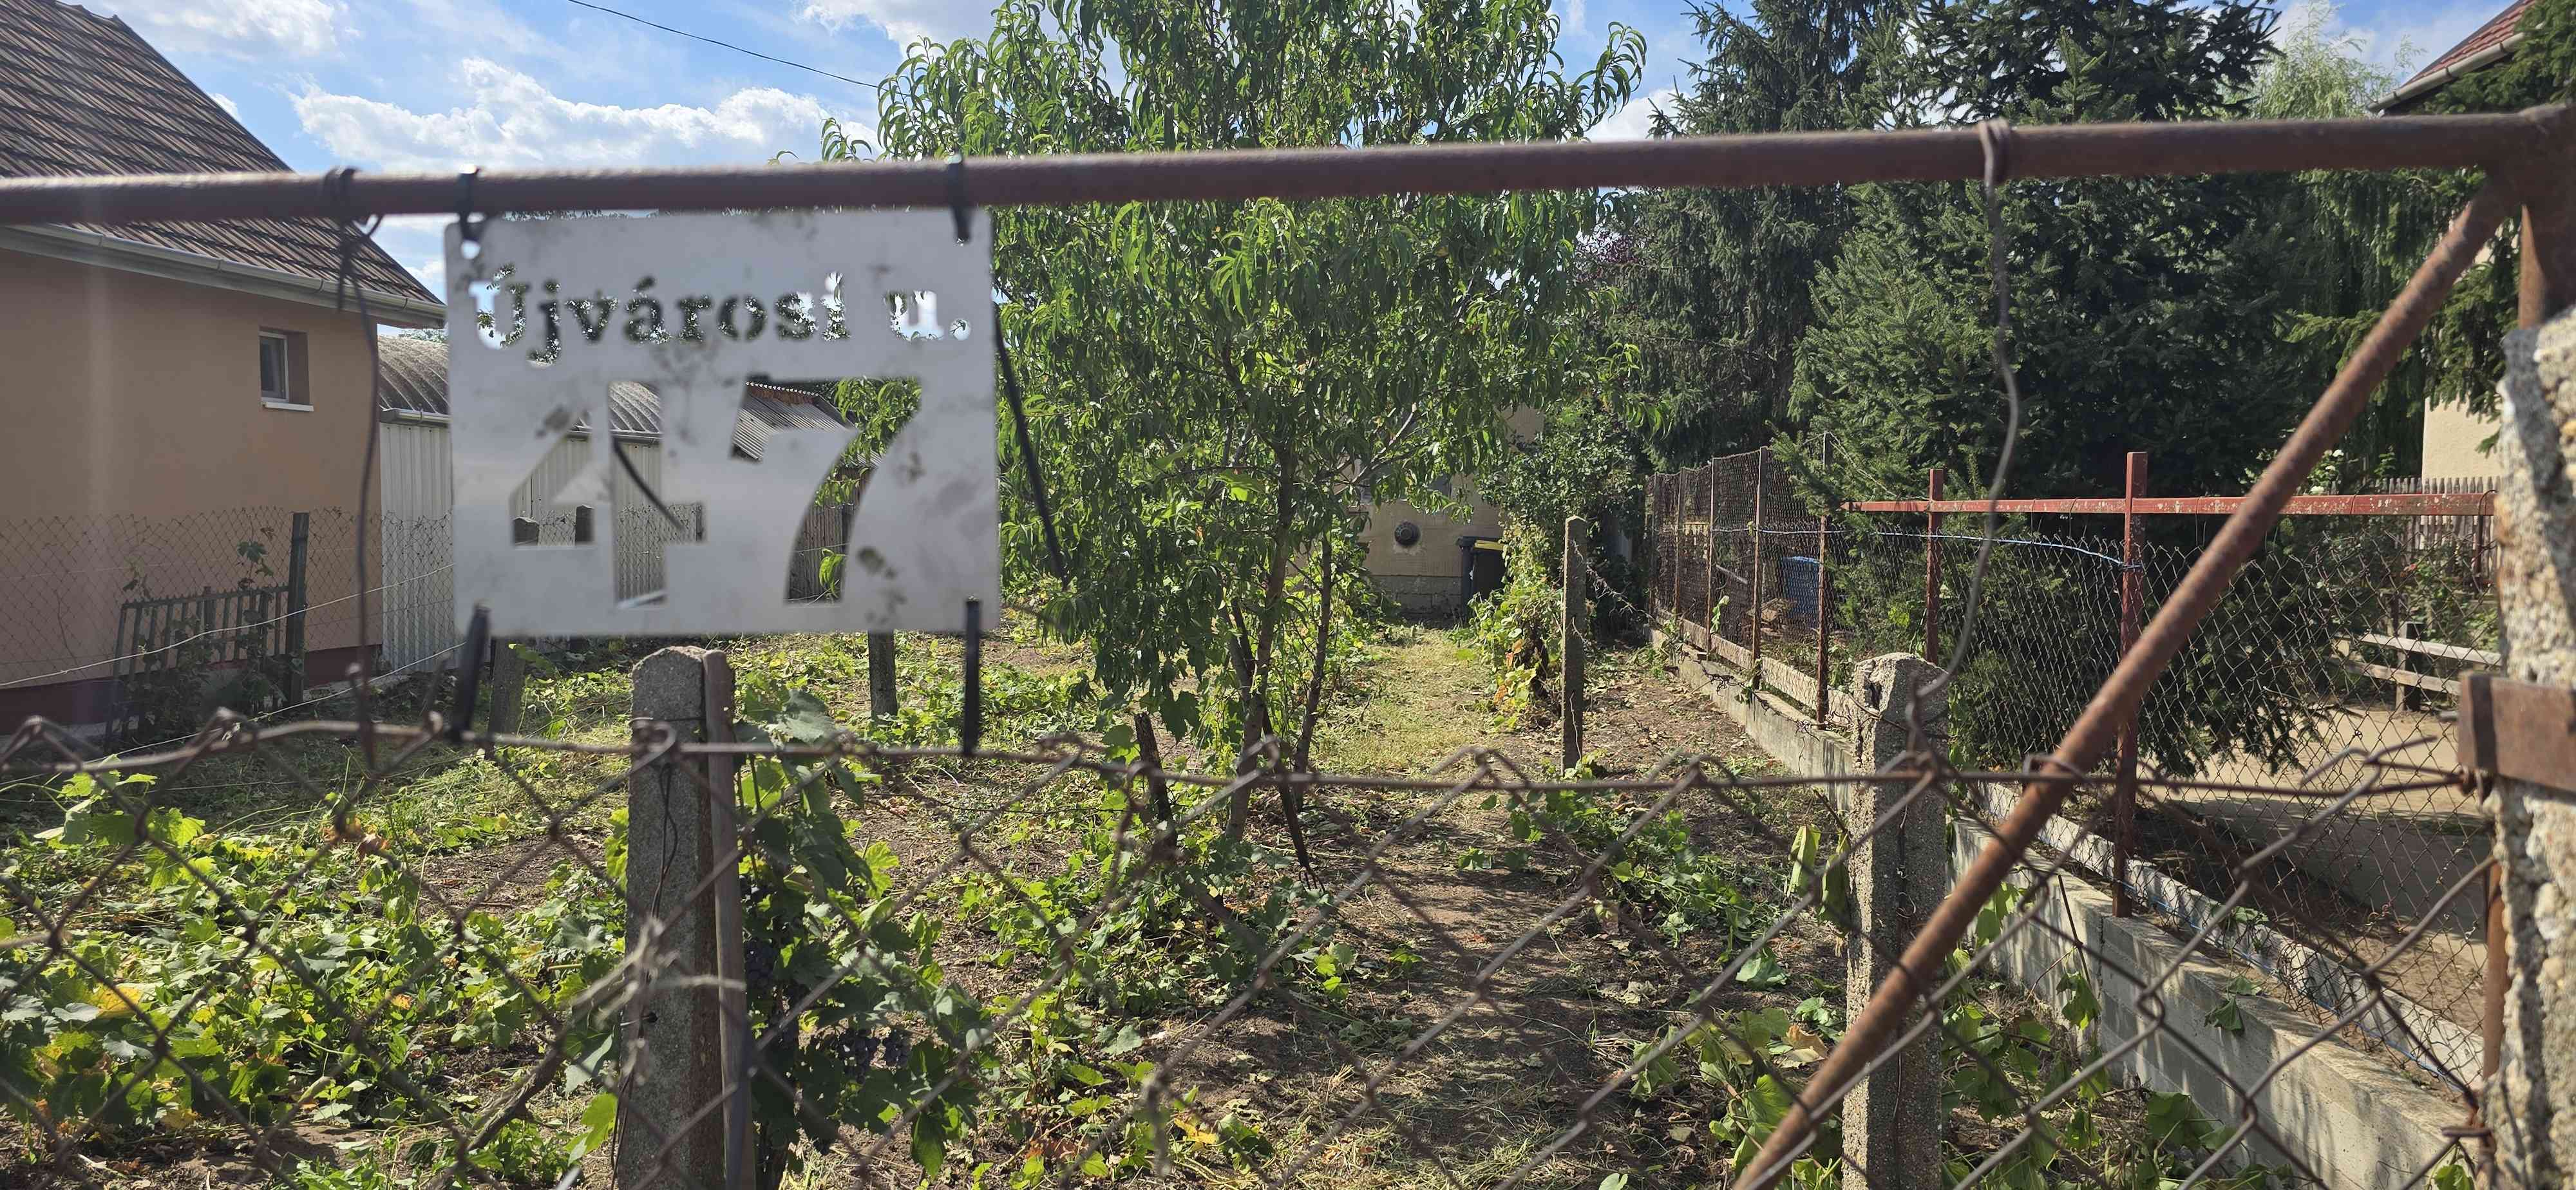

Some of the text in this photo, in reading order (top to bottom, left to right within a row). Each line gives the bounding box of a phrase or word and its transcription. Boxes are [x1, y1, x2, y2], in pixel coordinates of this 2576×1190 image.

[468, 263, 973, 367] Újvárosi u.
[509, 376, 922, 609] 47
